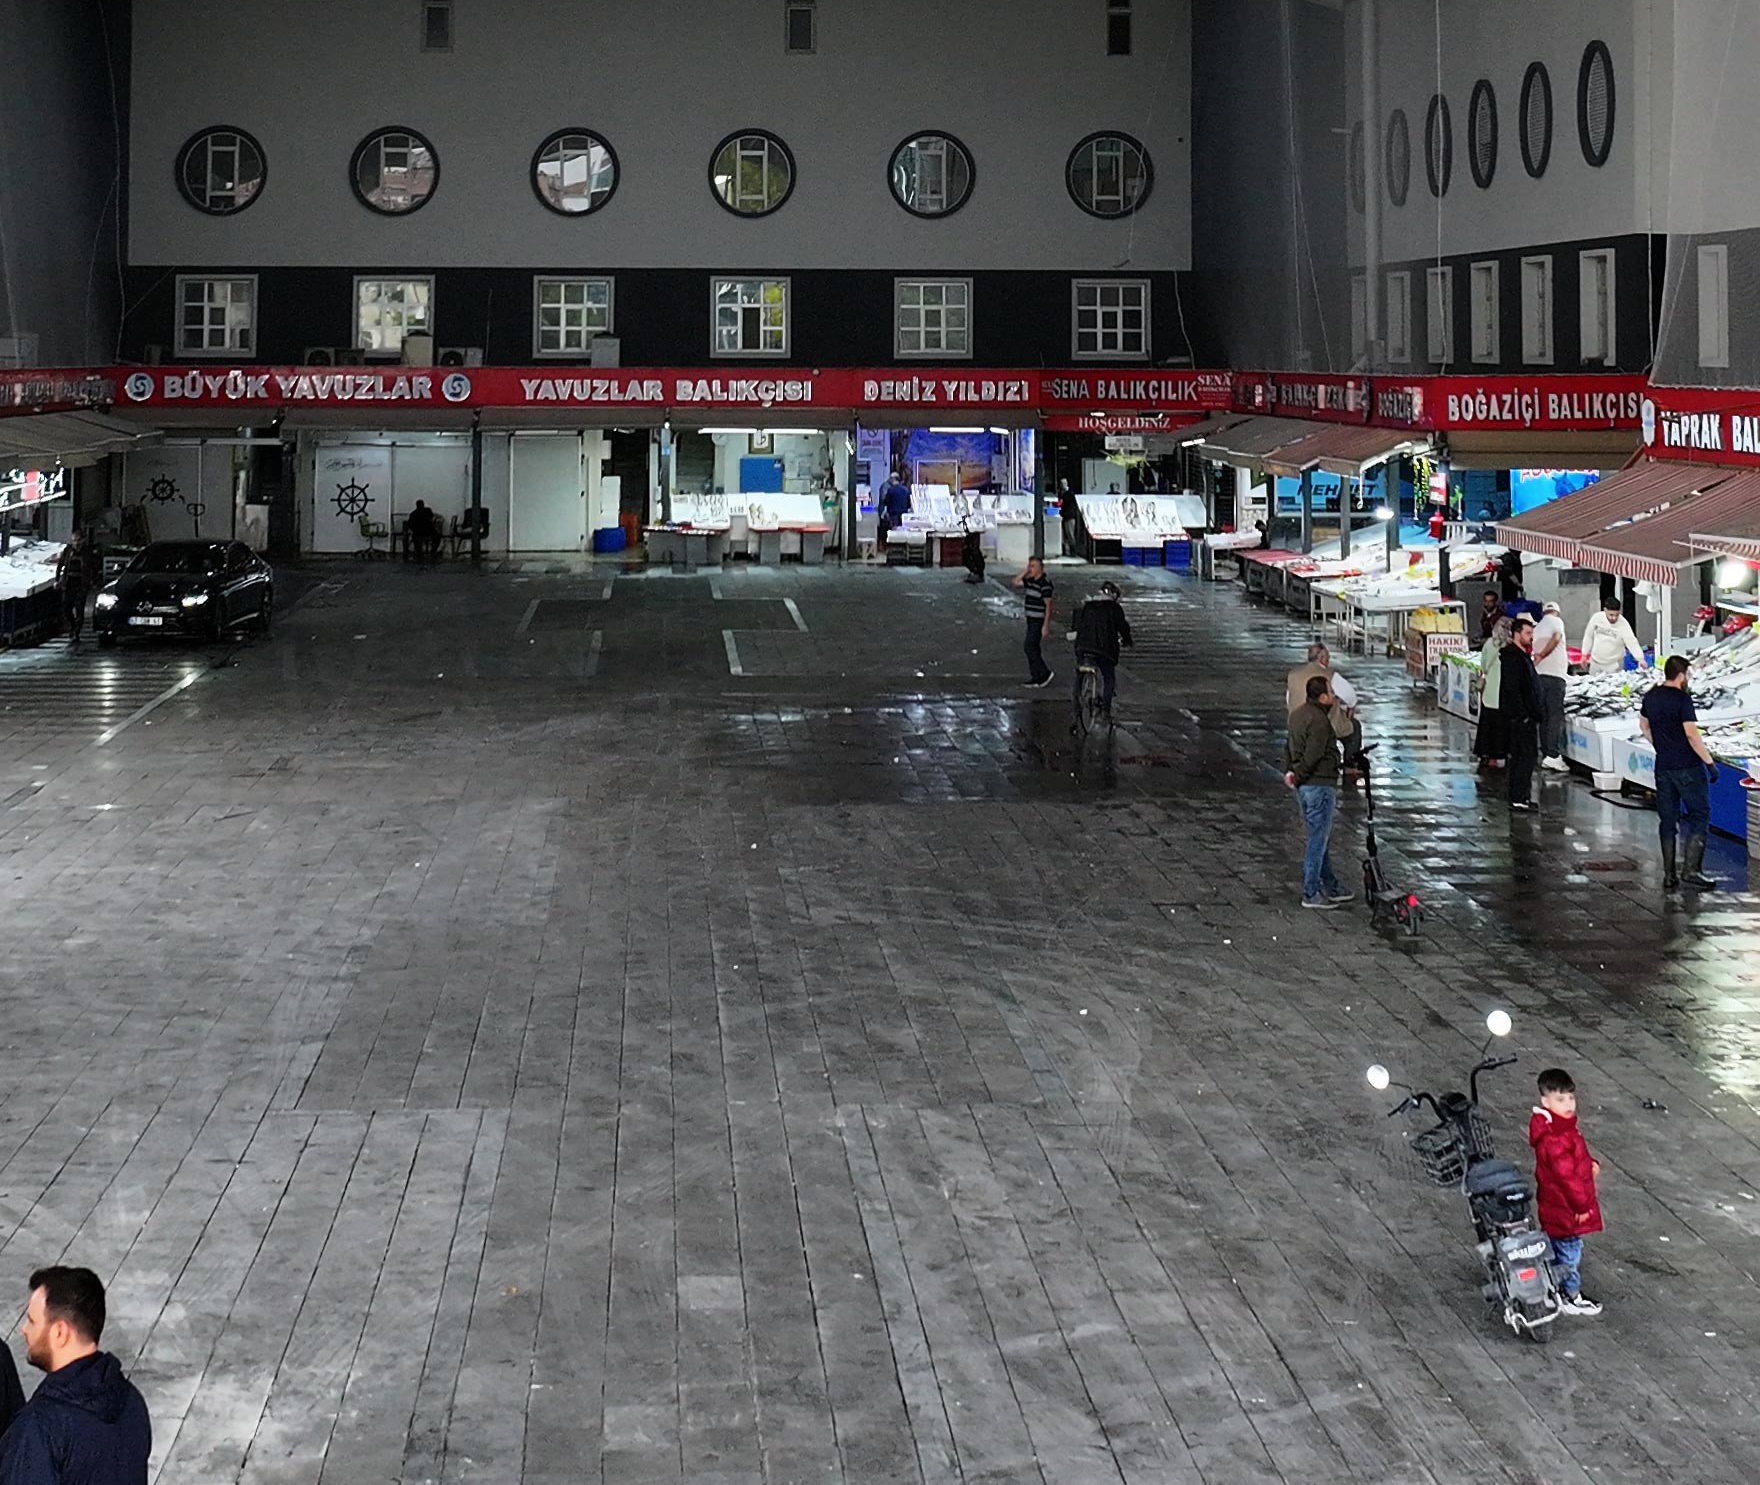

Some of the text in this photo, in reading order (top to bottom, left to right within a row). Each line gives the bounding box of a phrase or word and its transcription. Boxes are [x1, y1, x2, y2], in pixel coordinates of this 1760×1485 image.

[164, 370, 431, 400] BÜYÜK YAVUZLAR
[521, 379, 812, 407] YAVUZLAR BALIKÇISI
[864, 376, 936, 402] DENİZ
[942, 379, 1029, 402] YILDIZI
[1053, 378, 1090, 399] SENA
[1097, 379, 1198, 406] BALIKÇILIK
[1447, 387, 1540, 427] BOĞAZİÇİ
[1660, 412, 1723, 450] YAPRAK
